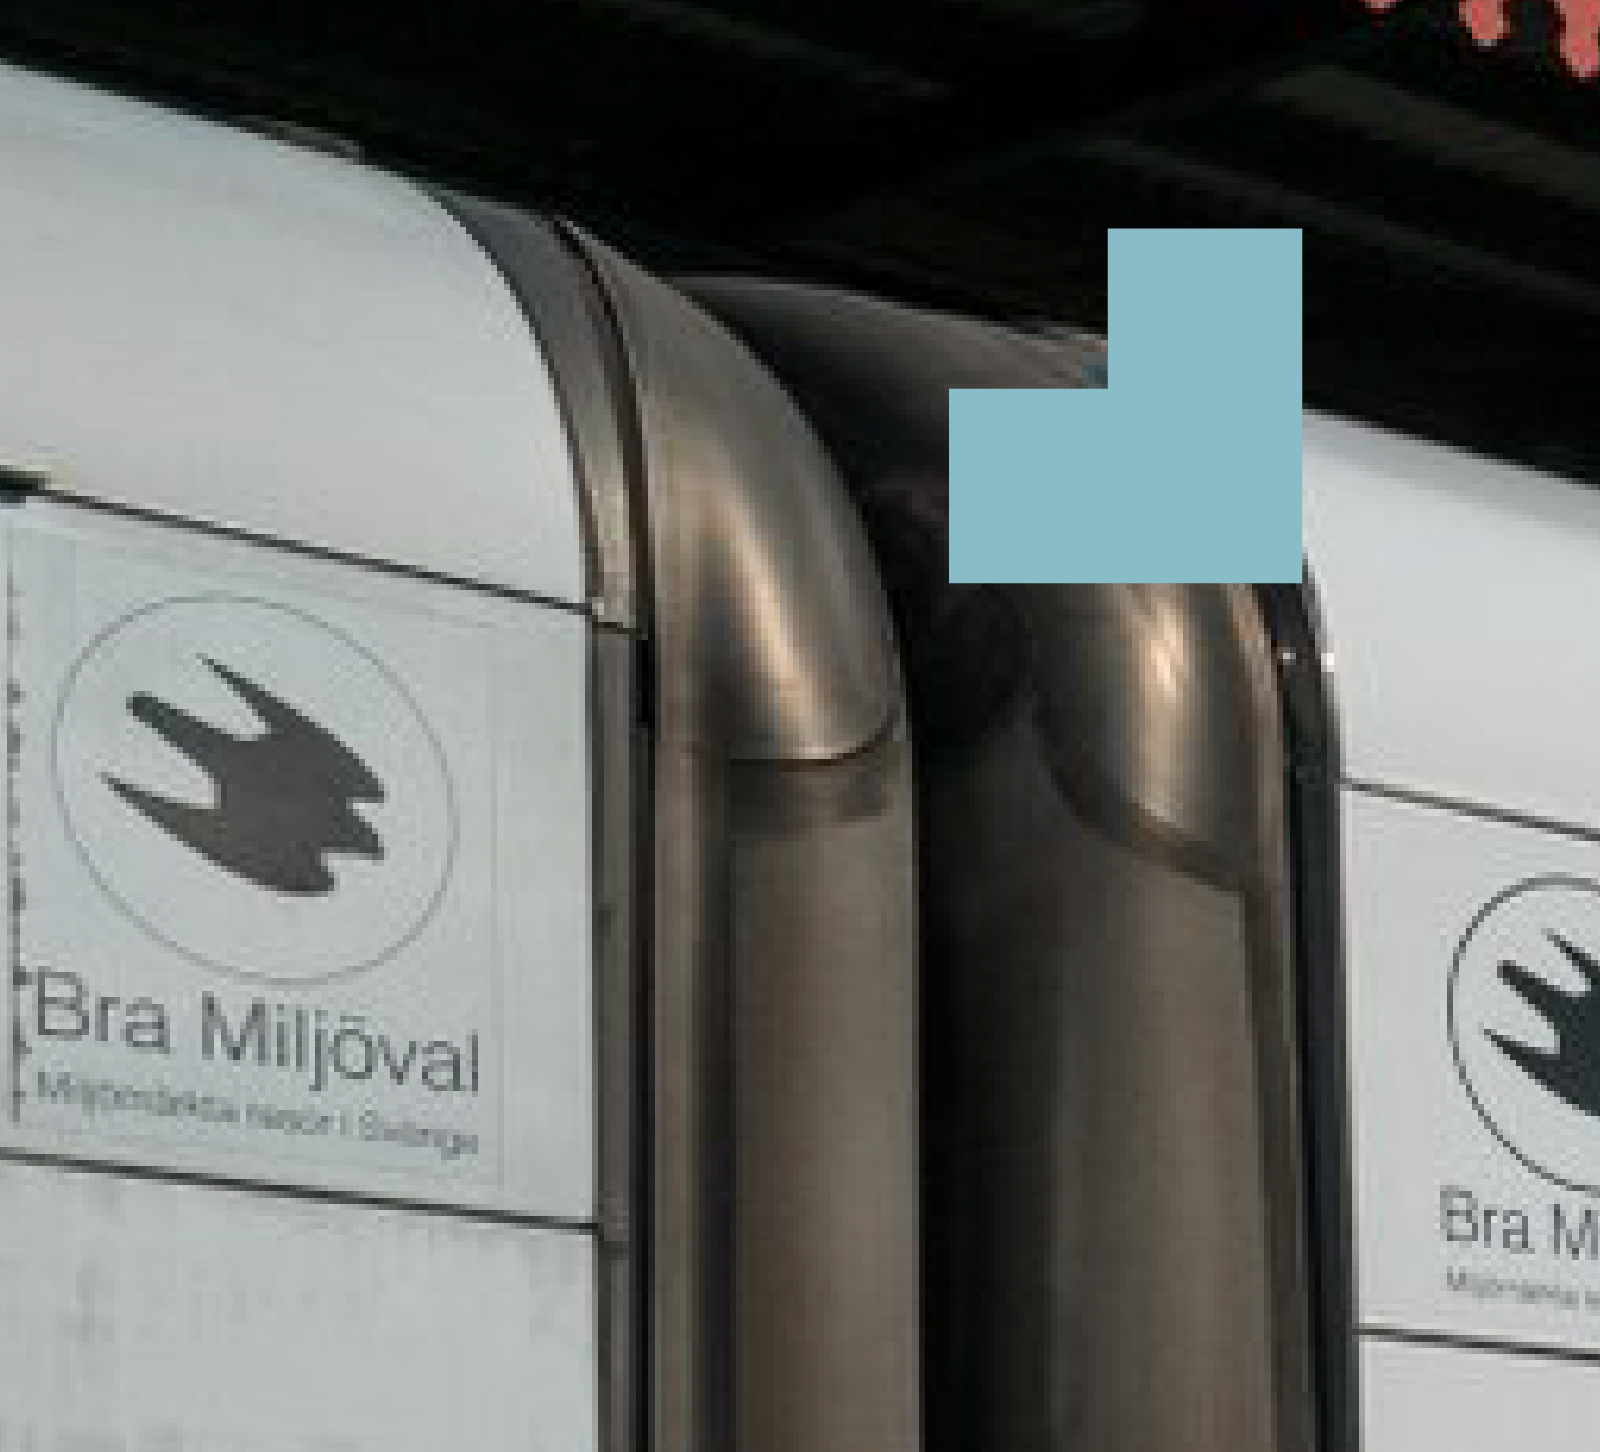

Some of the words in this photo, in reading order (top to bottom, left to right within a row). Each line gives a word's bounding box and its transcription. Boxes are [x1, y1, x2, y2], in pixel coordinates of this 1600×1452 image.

[34, 966, 170, 1054] Bra
[200, 991, 480, 1092] Miljöval
[1439, 1184, 1536, 1255] Bra
